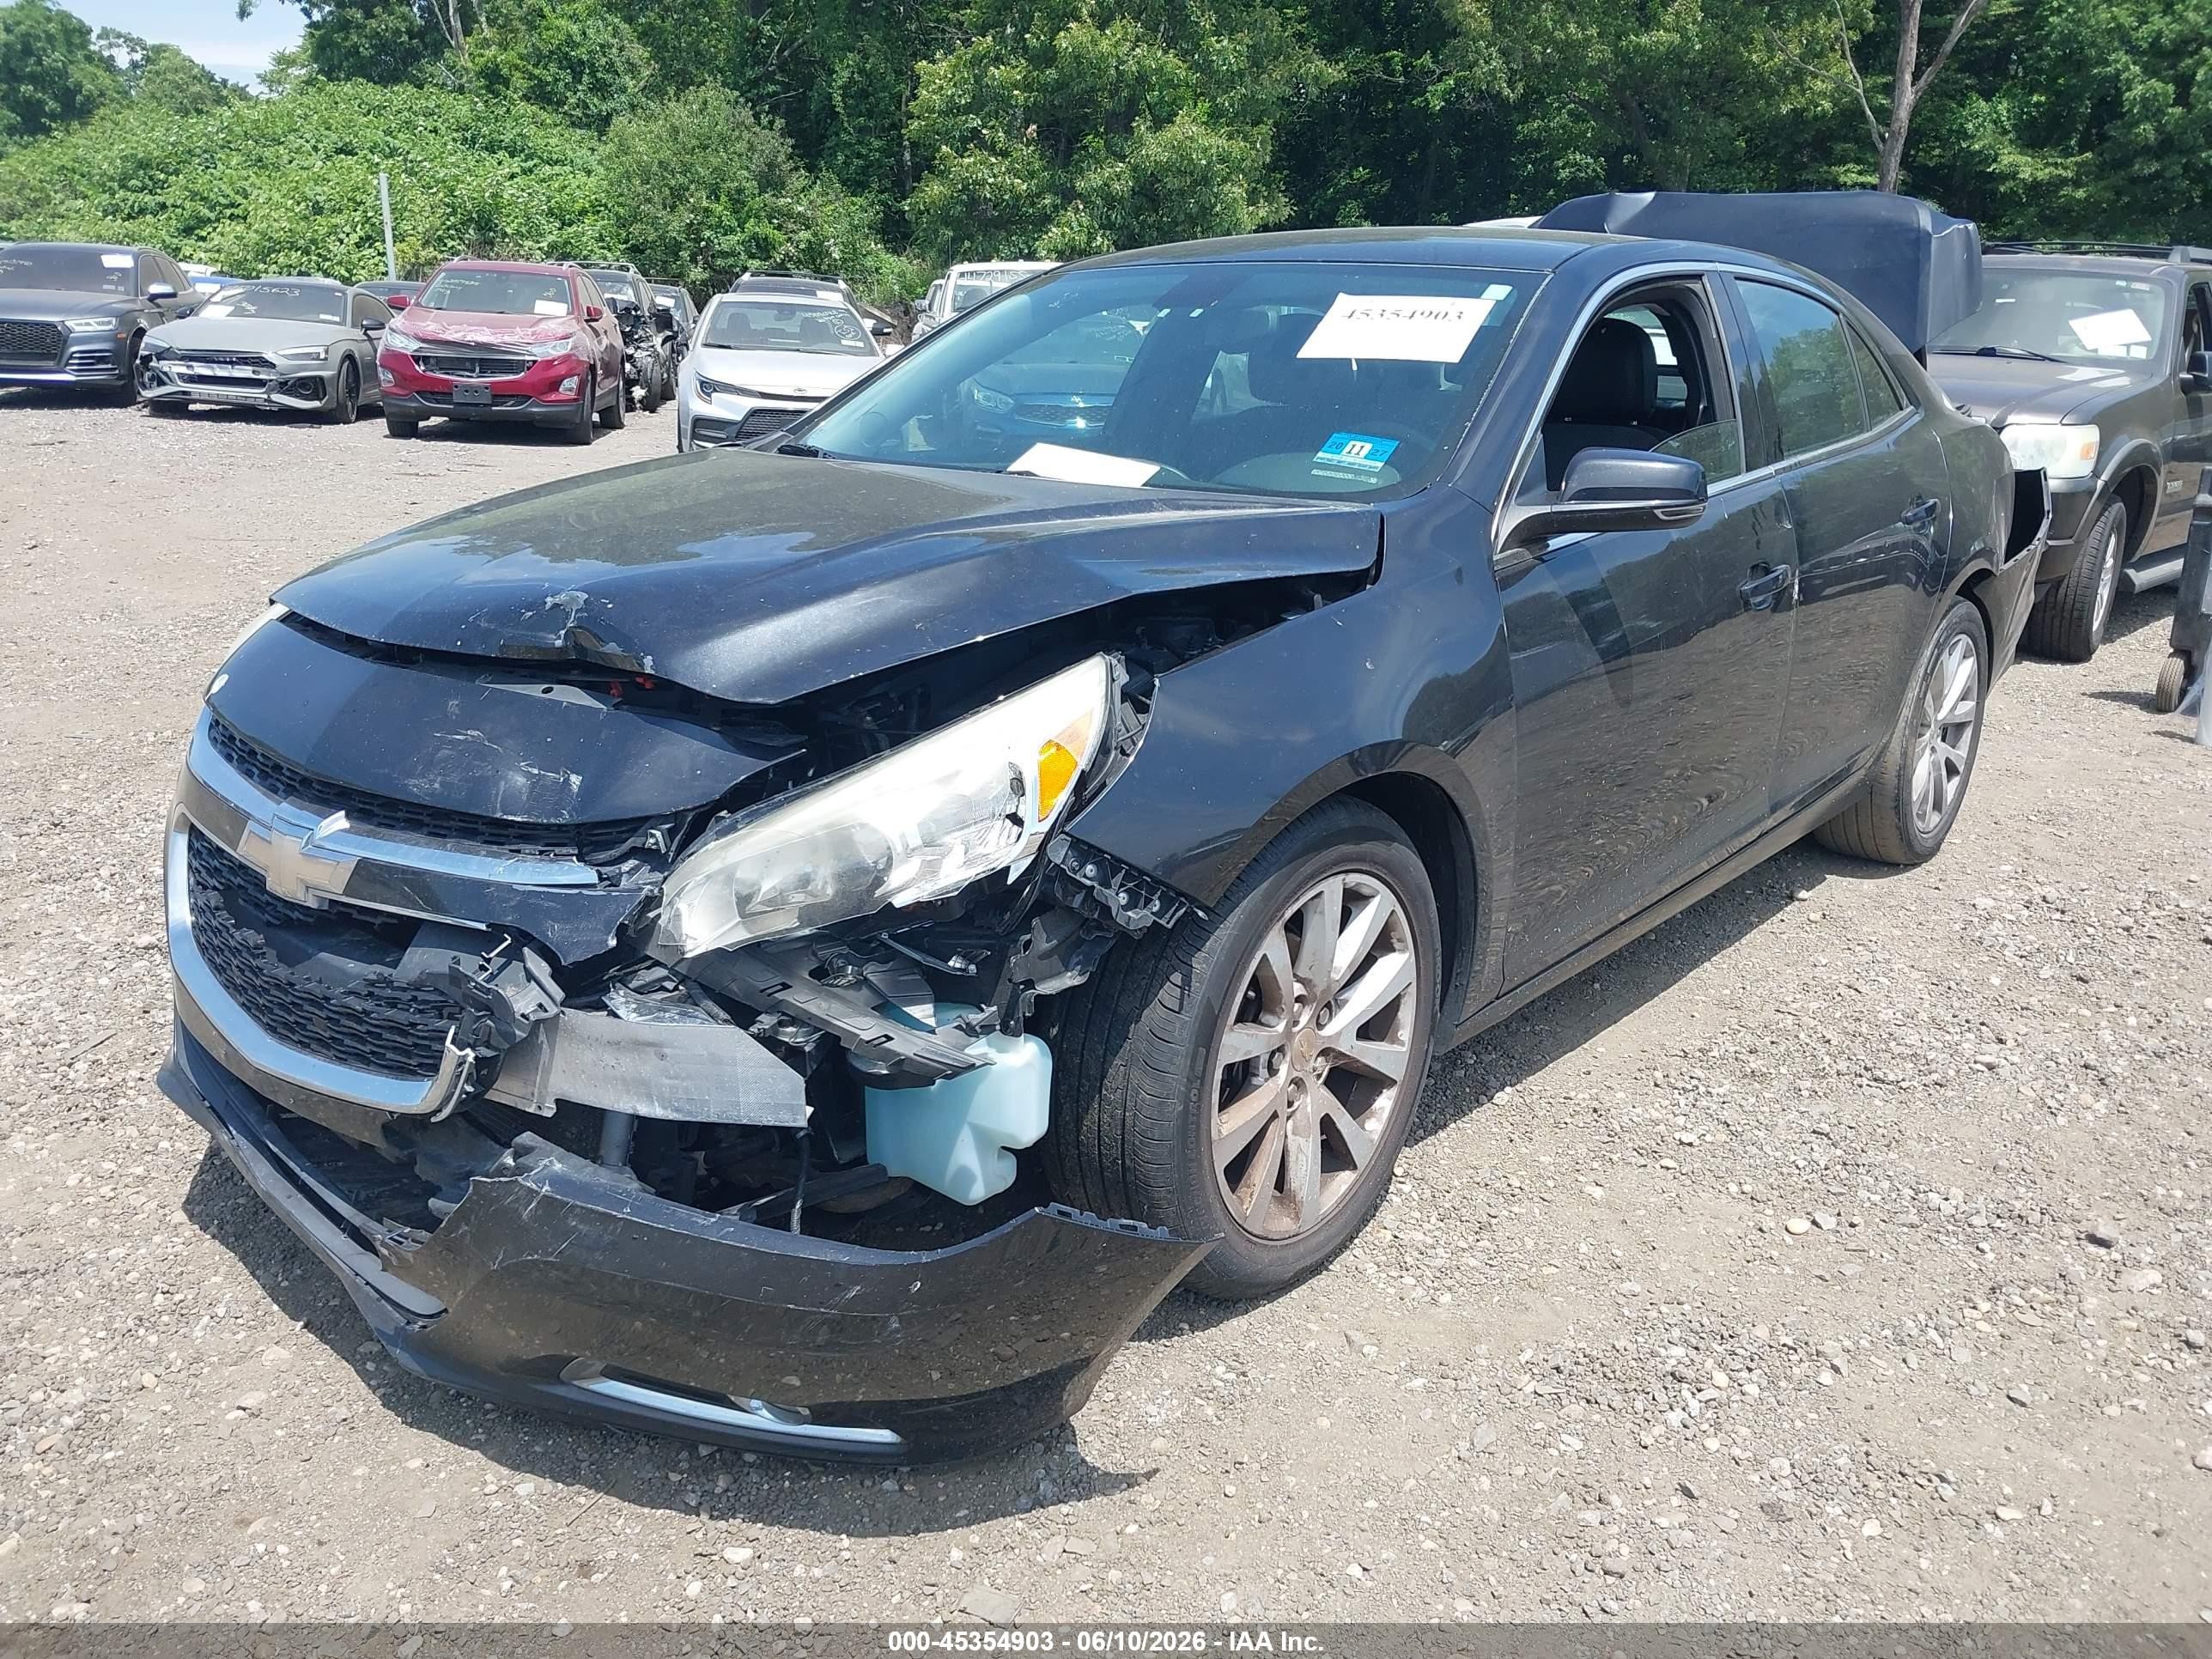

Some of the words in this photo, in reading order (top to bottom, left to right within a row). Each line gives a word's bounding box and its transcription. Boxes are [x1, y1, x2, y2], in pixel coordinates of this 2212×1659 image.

[1340, 308, 1465, 321] 45354903
[1328, 441, 1345, 450] 20
[1345, 443, 1366, 456] 11
[1370, 448, 1389, 458] 27
